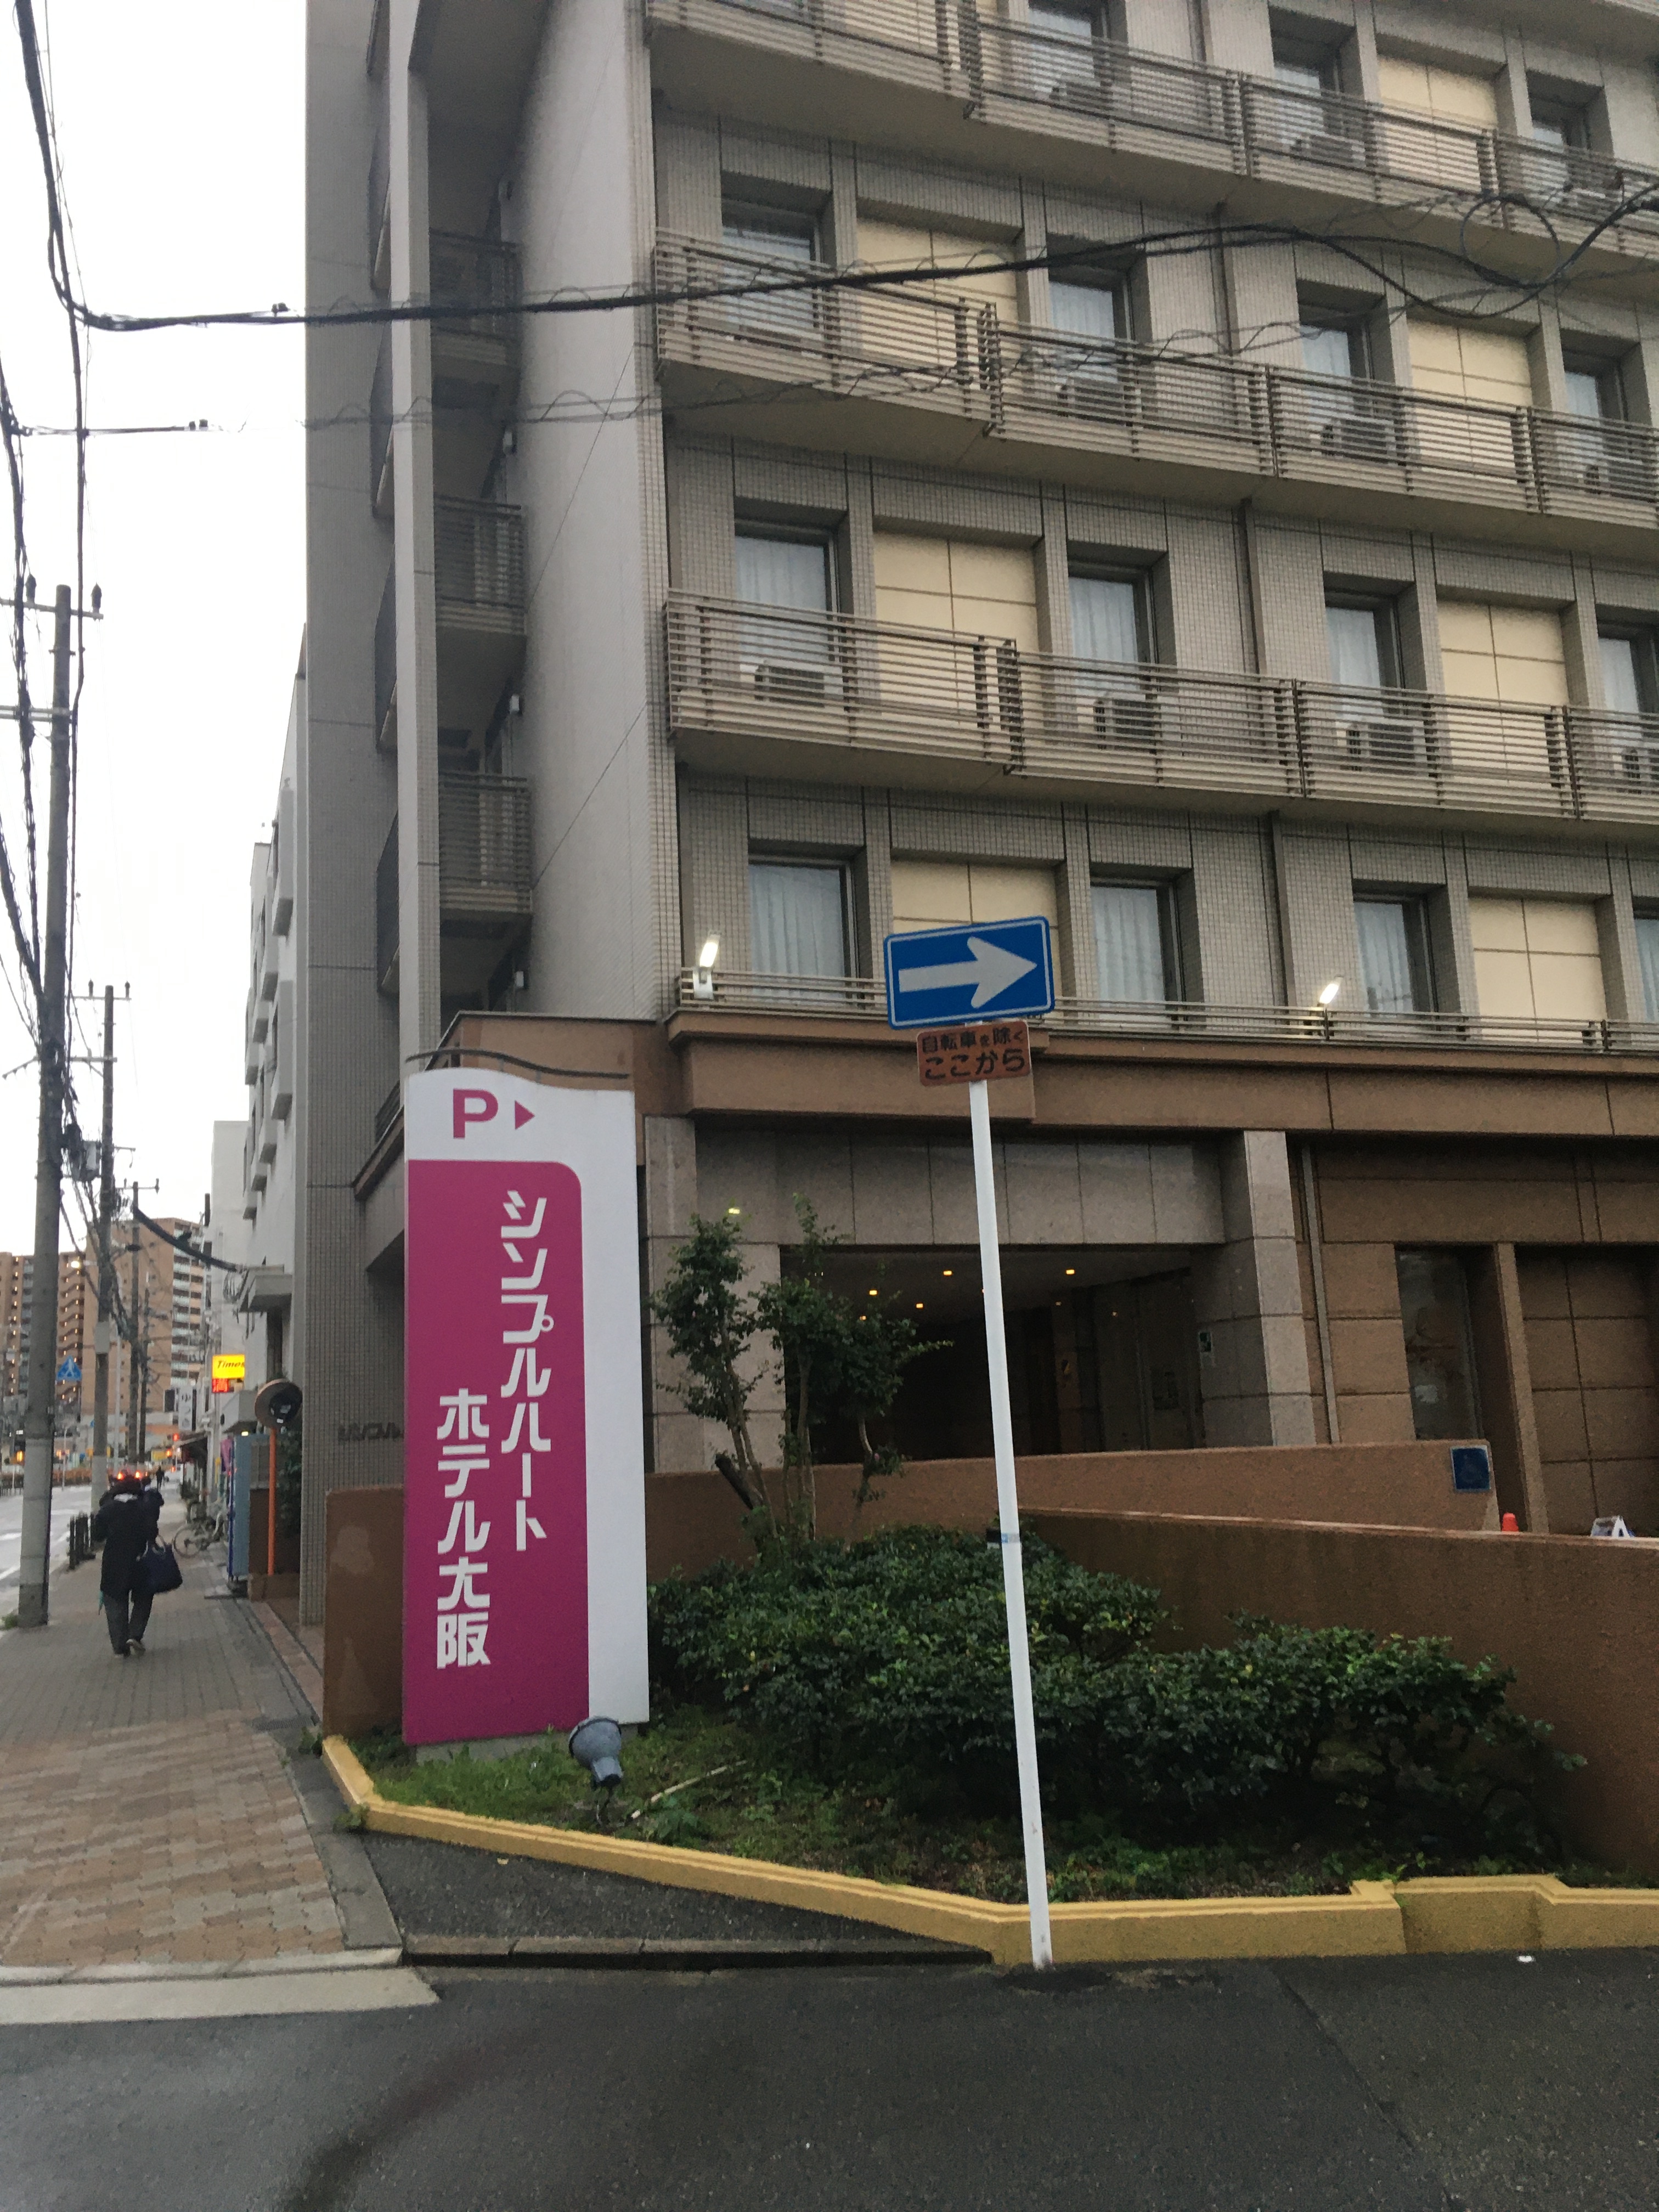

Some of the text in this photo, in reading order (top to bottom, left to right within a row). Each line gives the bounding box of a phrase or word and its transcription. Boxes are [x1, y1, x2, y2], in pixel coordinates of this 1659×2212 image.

[453, 1089, 499, 1139] P
[924, 1048, 1025, 1080] ここから
[500, 1190, 554, 1551] シンプルハート
[437, 1387, 491, 1669] ホテル大阪
